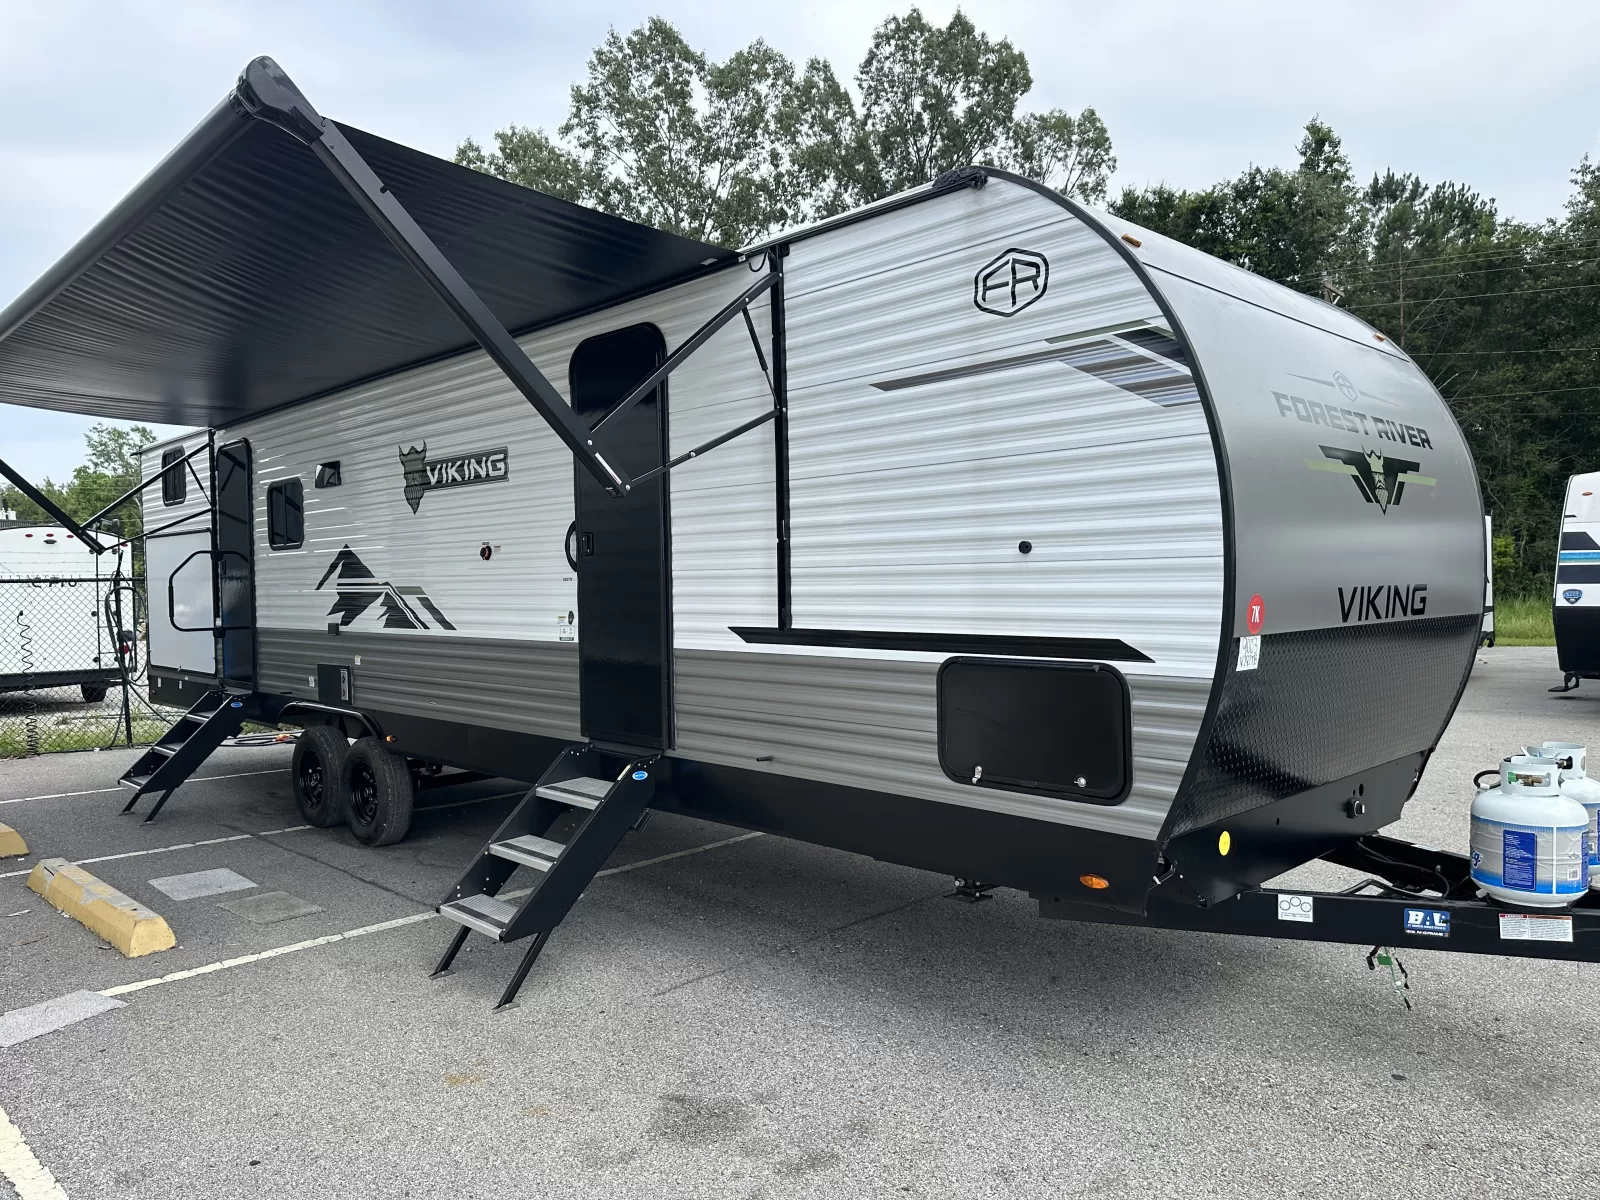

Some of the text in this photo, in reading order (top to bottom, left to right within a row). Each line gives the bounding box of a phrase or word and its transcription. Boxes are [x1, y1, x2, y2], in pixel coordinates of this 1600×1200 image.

[1270, 390, 1434, 450] FOREST RIVER
[425, 453, 506, 486] VIKING
[1250, 605, 1261, 623] 7K
[1337, 583, 1428, 623] VIKING
